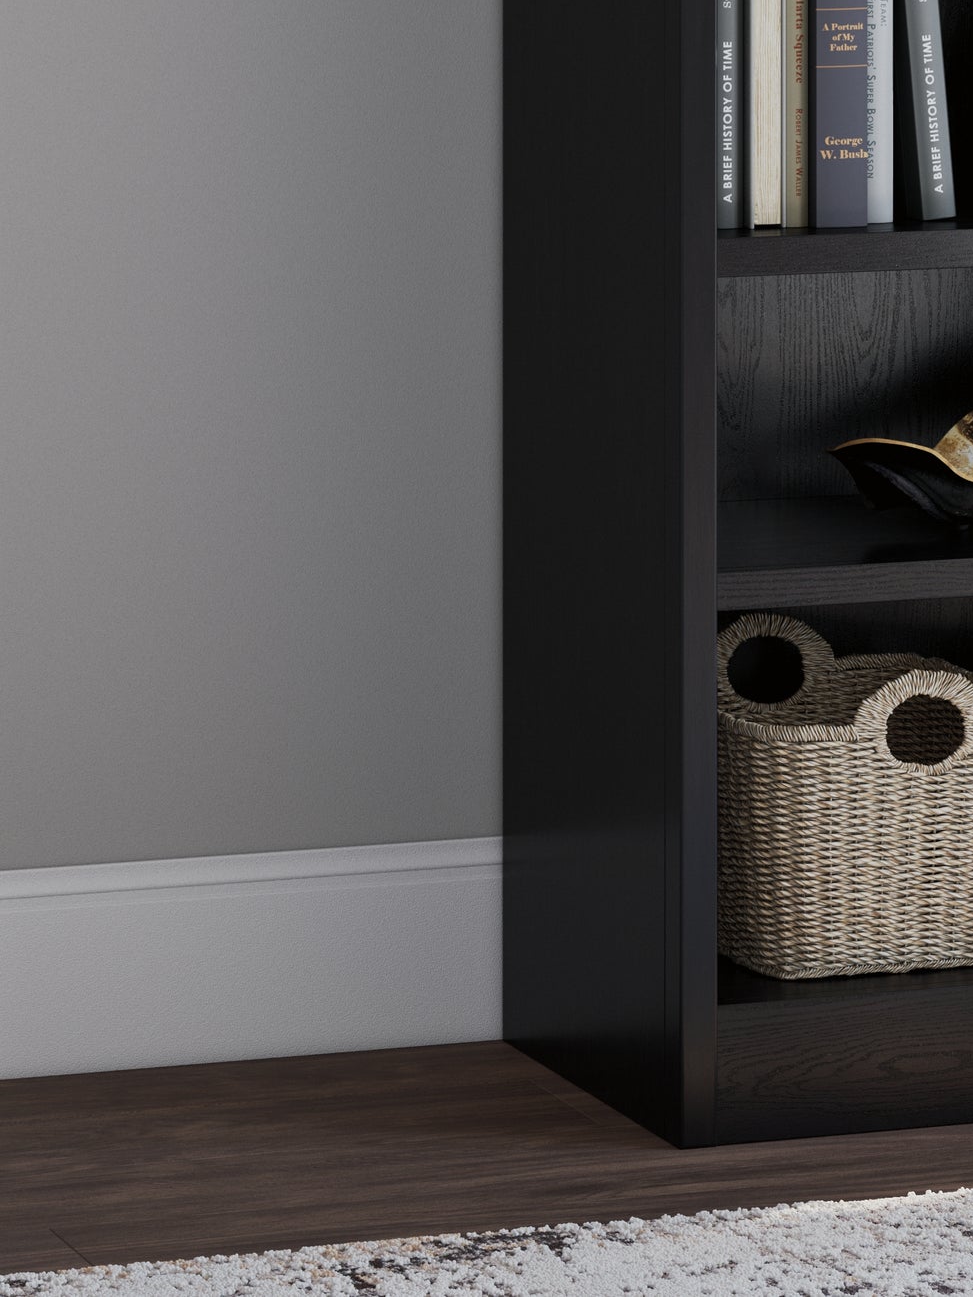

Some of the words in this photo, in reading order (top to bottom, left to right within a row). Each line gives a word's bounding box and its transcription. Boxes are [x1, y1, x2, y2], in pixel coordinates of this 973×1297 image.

[822, 23, 829, 31] A
[831, 22, 864, 31] Portrait
[831, 33, 841, 41] of
[842, 33, 855, 42] My
[723, 41, 733, 71] TIME
[830, 43, 858, 52] Father
[921, 34, 933, 63] TIME
[793, 34, 804, 84] Squeeze
[723, 75, 733, 93] OF
[924, 68, 935, 84] OF
[723, 98, 733, 151] HISTORY
[926, 90, 939, 142] HISTORY
[824, 136, 863, 147] George
[820, 149, 837, 160] W.
[839, 148, 869, 160] Bush
[931, 146, 943, 180] BRIEF
[723, 155, 733, 189] BRIEF
[934, 184, 944, 193] A
[723, 193, 733, 203] A
